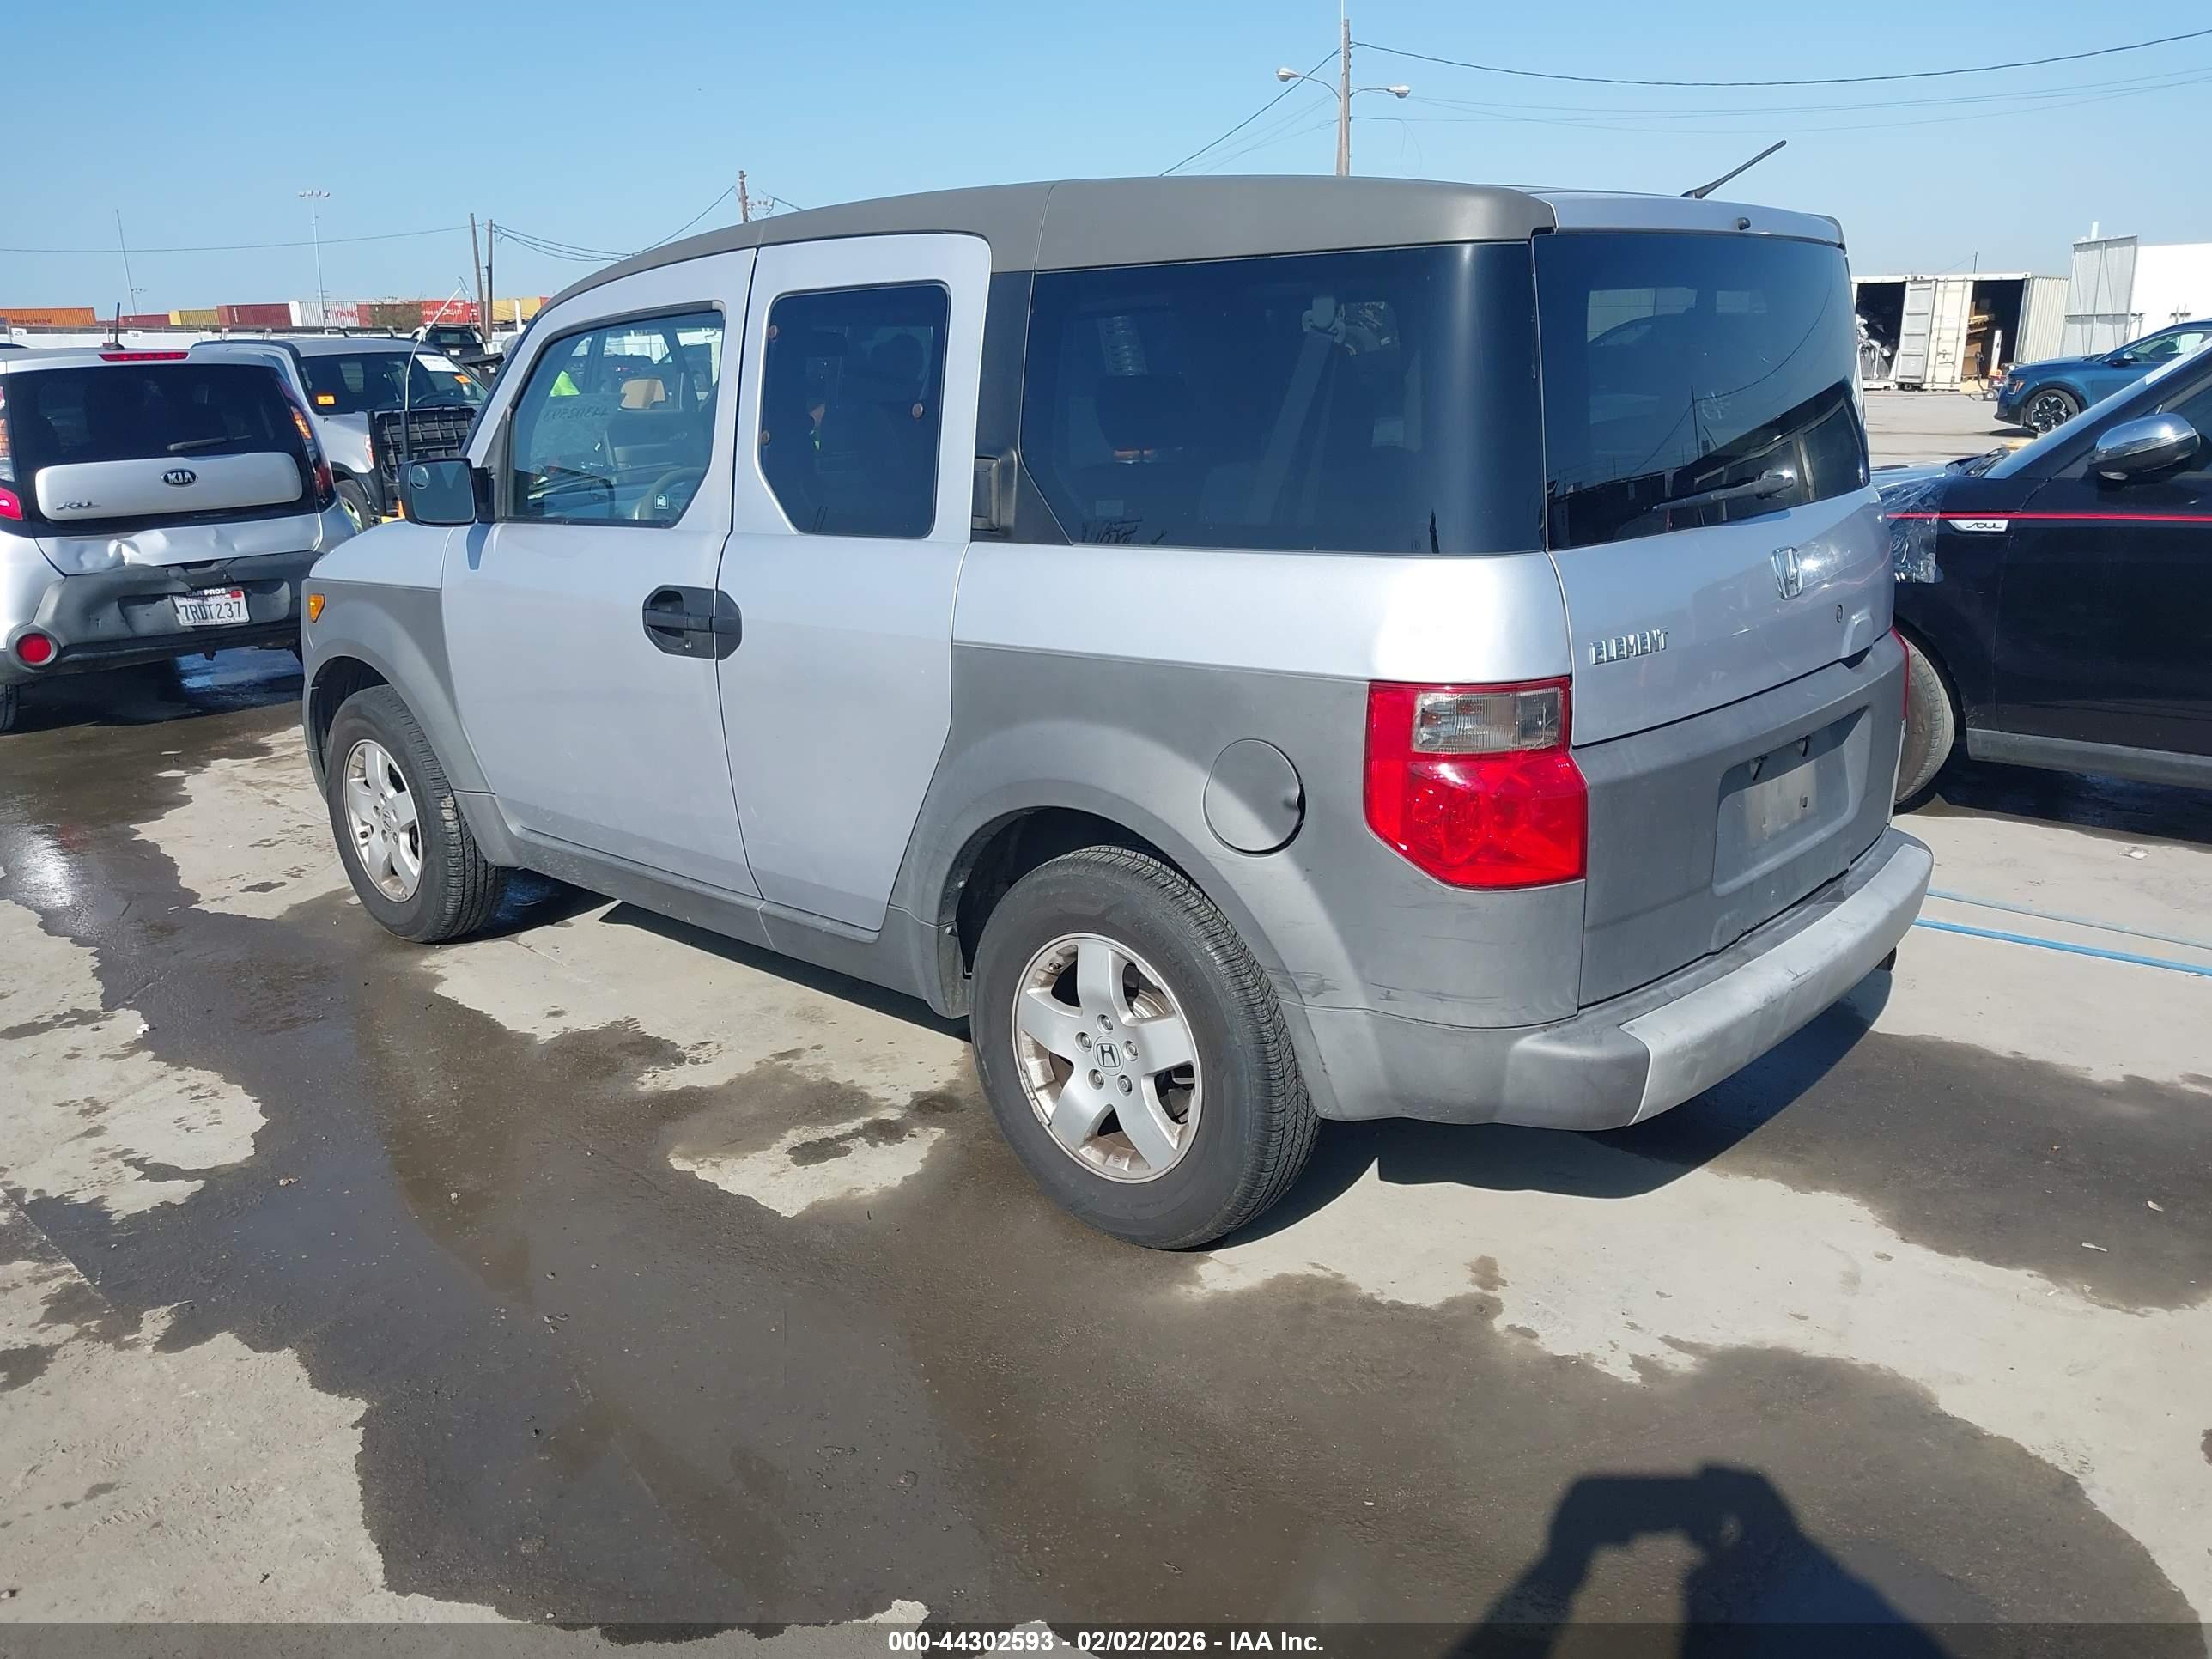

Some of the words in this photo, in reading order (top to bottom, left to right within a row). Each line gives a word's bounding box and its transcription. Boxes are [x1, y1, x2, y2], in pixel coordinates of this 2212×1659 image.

[167, 472, 194, 483] KIA
[179, 601, 241, 621] 7RDT237
[1589, 628, 1668, 665] ELEMENT
